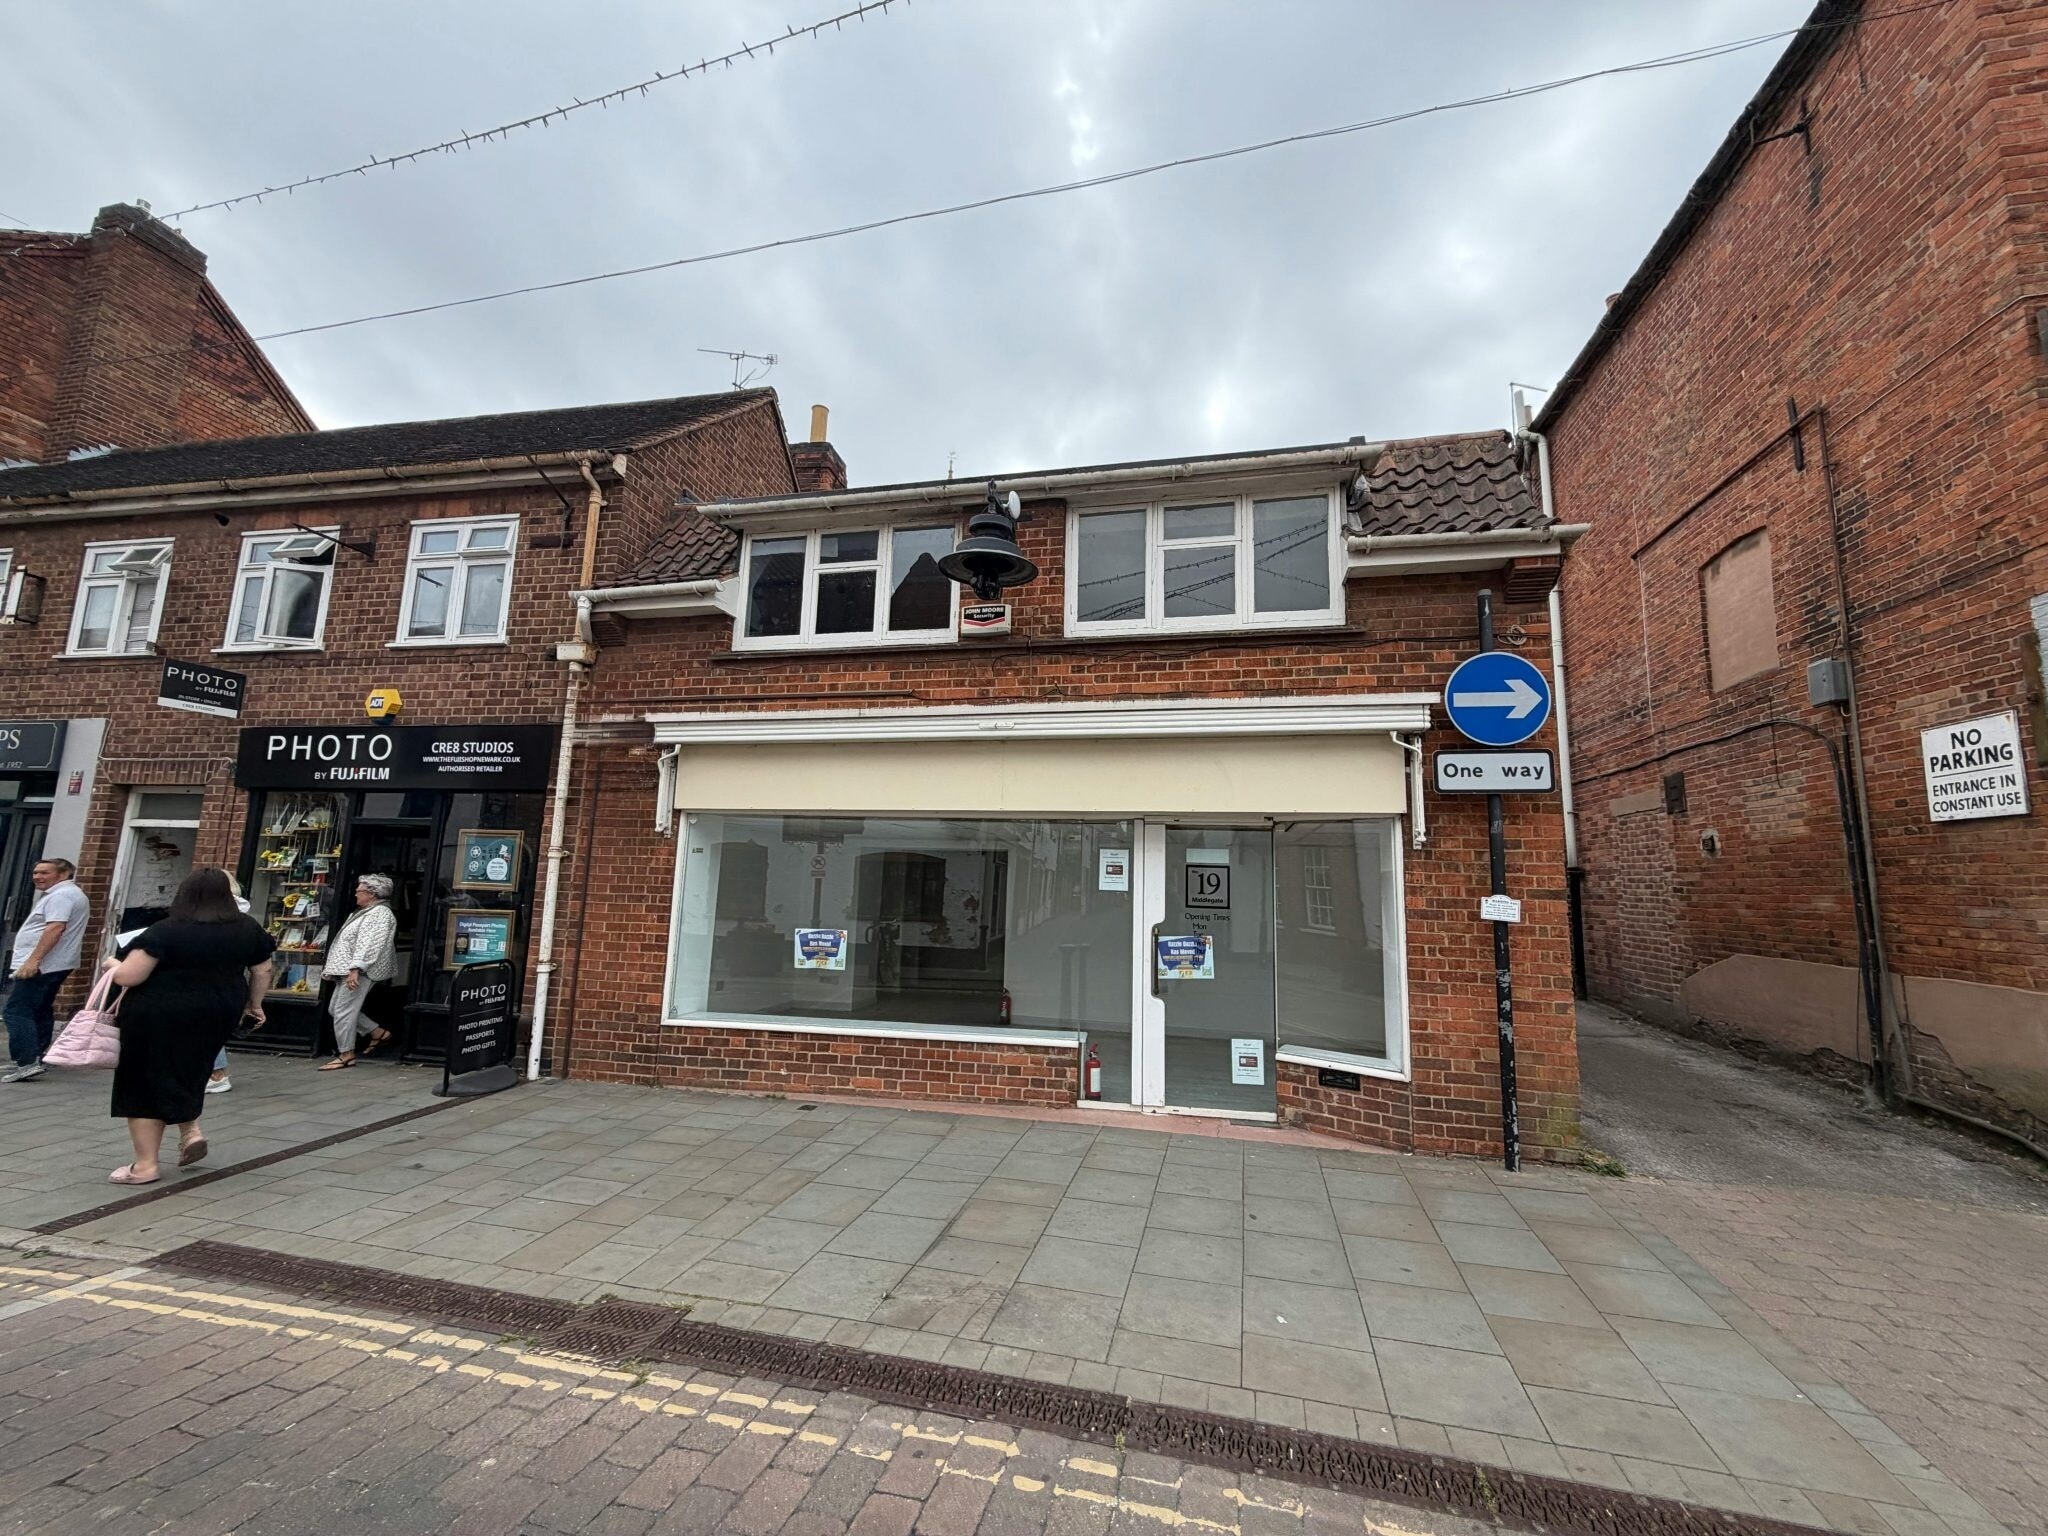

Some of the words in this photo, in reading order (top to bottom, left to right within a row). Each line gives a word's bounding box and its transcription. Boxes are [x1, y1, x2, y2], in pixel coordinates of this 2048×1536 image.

[167, 667, 238, 690] PHOTO
[371, 698, 384, 708] ADT
[267, 734, 393, 760] PHOTO
[1950, 728, 1982, 749] NO
[431, 742, 460, 753] CRE8
[462, 742, 514, 753] STUDIOS
[1930, 743, 2013, 773] PARKING
[314, 772, 327, 780] BY
[330, 767, 390, 780] FUJIFILM
[1443, 763, 1484, 778] One
[1501, 765, 1544, 780] way
[1932, 776, 1997, 797] ENTRANCE
[2000, 773, 2017, 788] IN
[1932, 794, 1995, 813] CONSTANT
[1996, 791, 2022, 806] USE
[1197, 872, 1221, 895] 19
[1184, 912, 1211, 921] Opening
[1212, 913, 1231, 921] Times
[1193, 922, 1207, 930] Mon
[461, 983, 507, 1002] PHOTO
[458, 1022, 478, 1031] PHOTO
[479, 1016, 503, 1027] PRINTING
[465, 1029, 495, 1041] PASSPORTS
[461, 1044, 481, 1055] PHOTO
[482, 1040, 496, 1049] GIFTS
